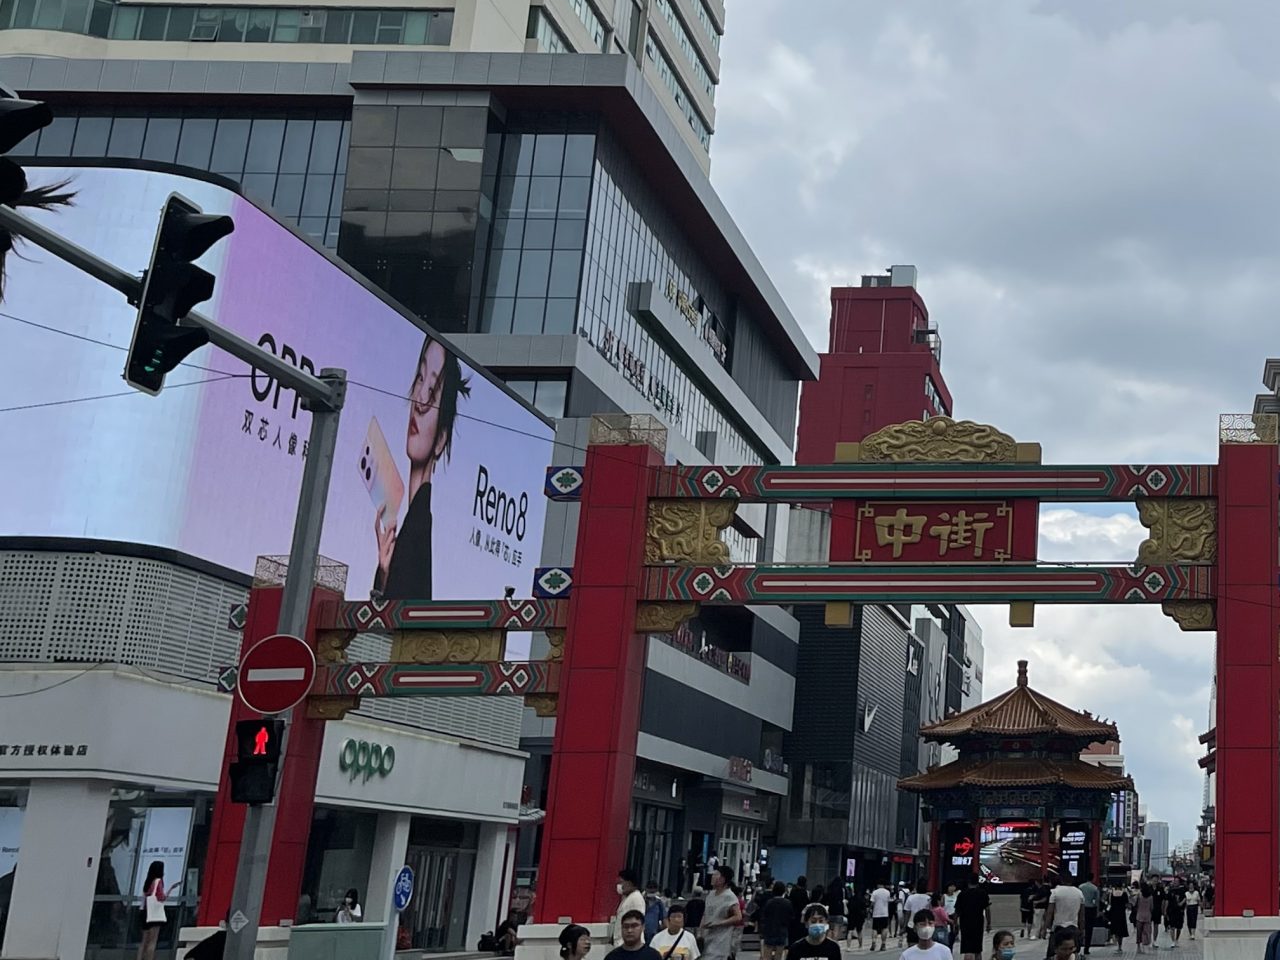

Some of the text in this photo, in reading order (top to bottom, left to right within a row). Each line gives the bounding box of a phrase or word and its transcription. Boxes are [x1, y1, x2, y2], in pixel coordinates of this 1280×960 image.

[250, 333, 316, 420] OPP
[473, 464, 528, 542] Reno8
[874, 508, 994, 558] 中街
[0, 744, 89, 757] 官方授权体验店
